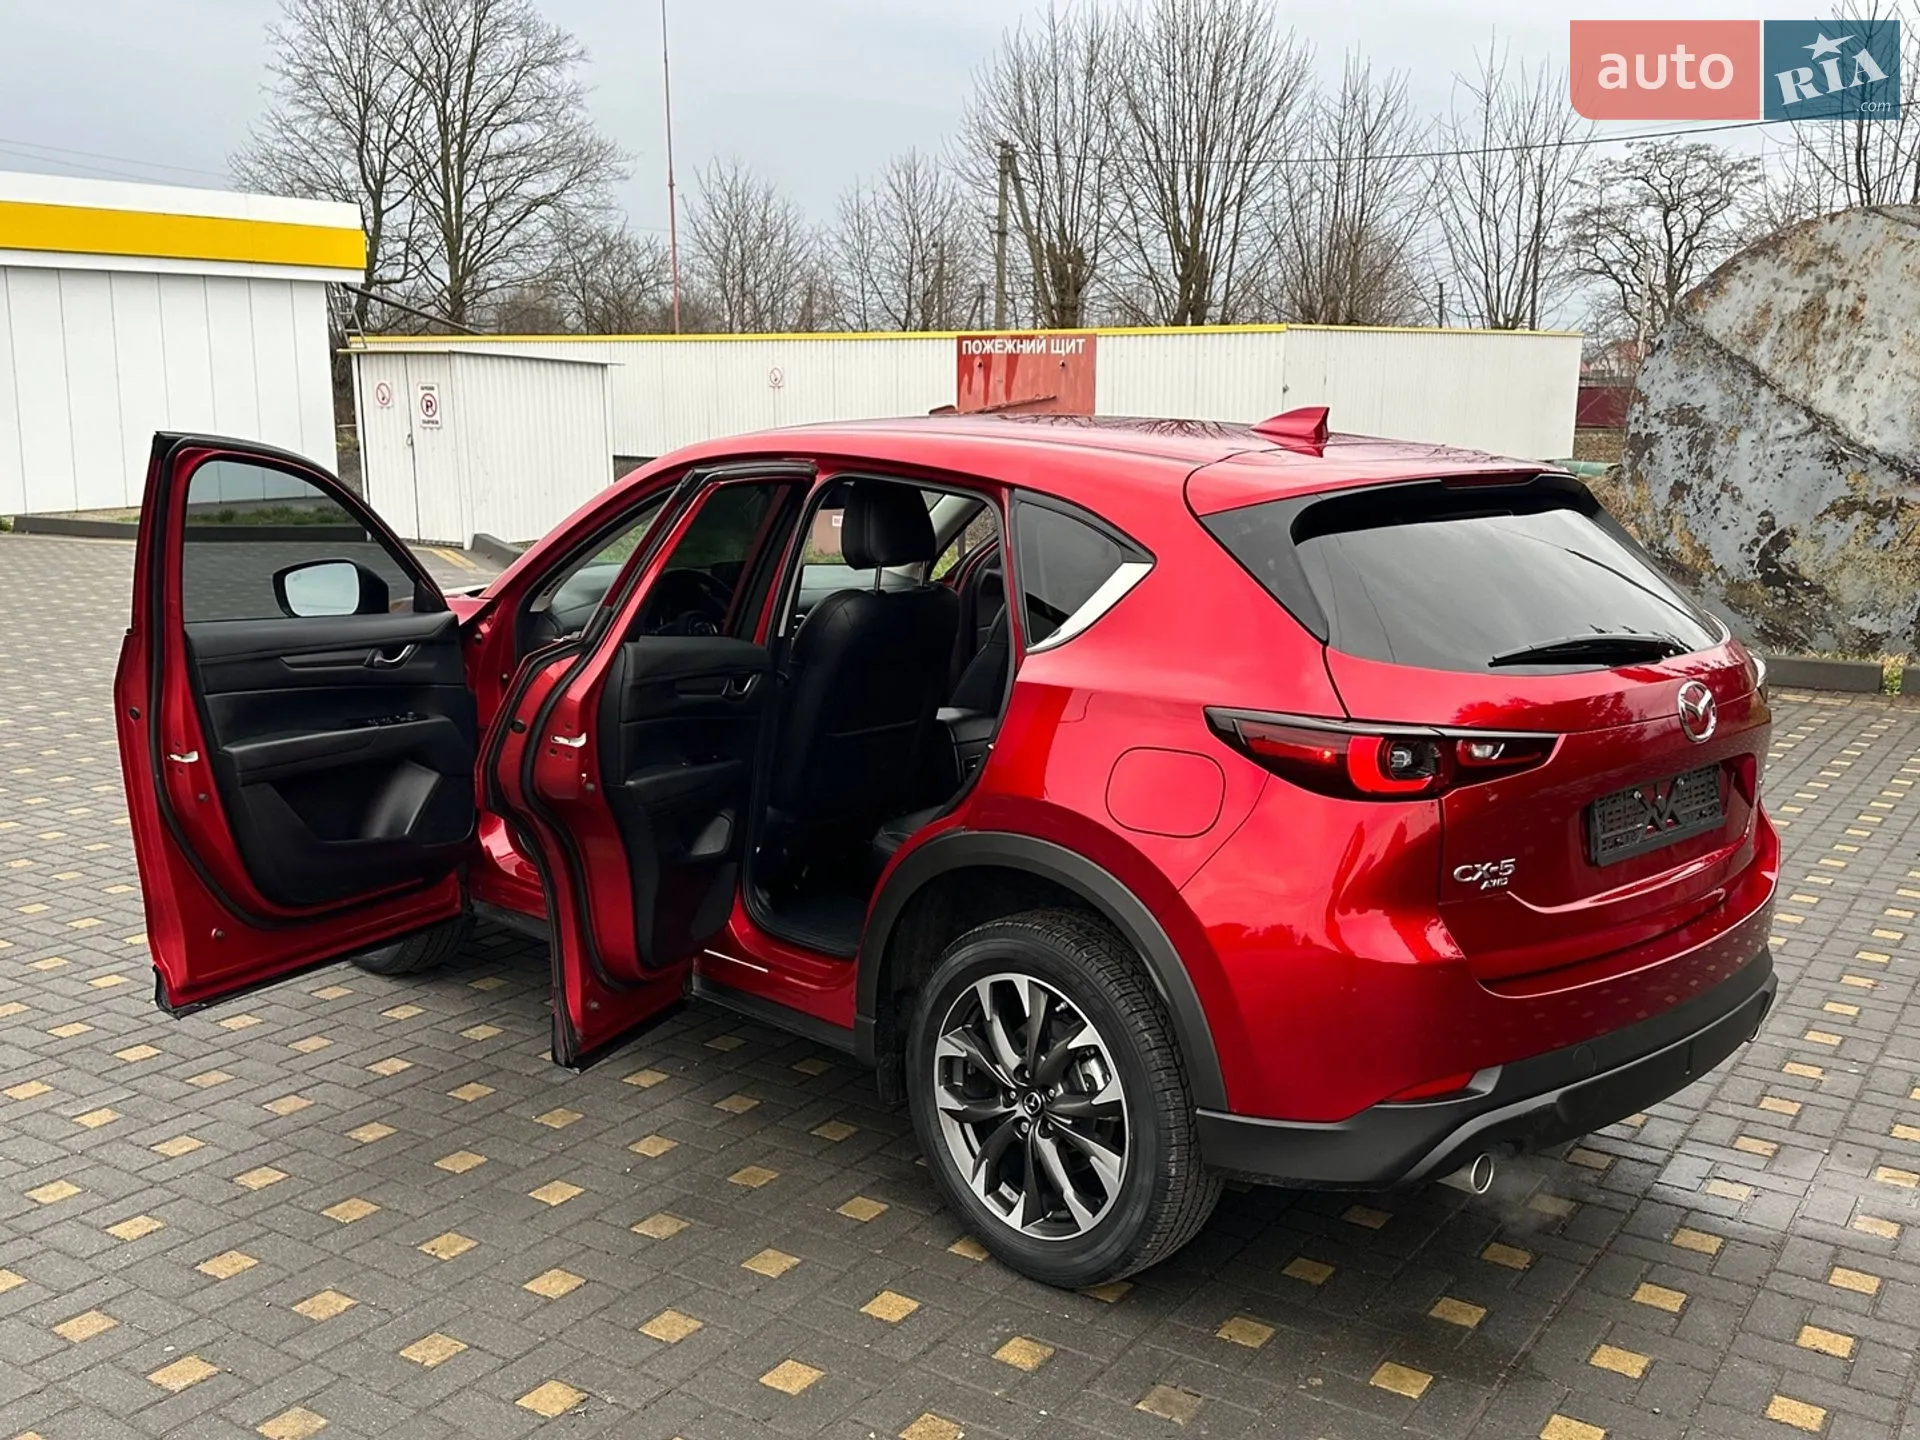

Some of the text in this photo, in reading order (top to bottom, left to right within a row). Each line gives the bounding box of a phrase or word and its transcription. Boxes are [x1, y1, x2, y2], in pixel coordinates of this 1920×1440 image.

[962, 337, 1085, 356] ПОЖЕЖНИЙ ЩИТ
[1453, 858, 1516, 882] CX-5
